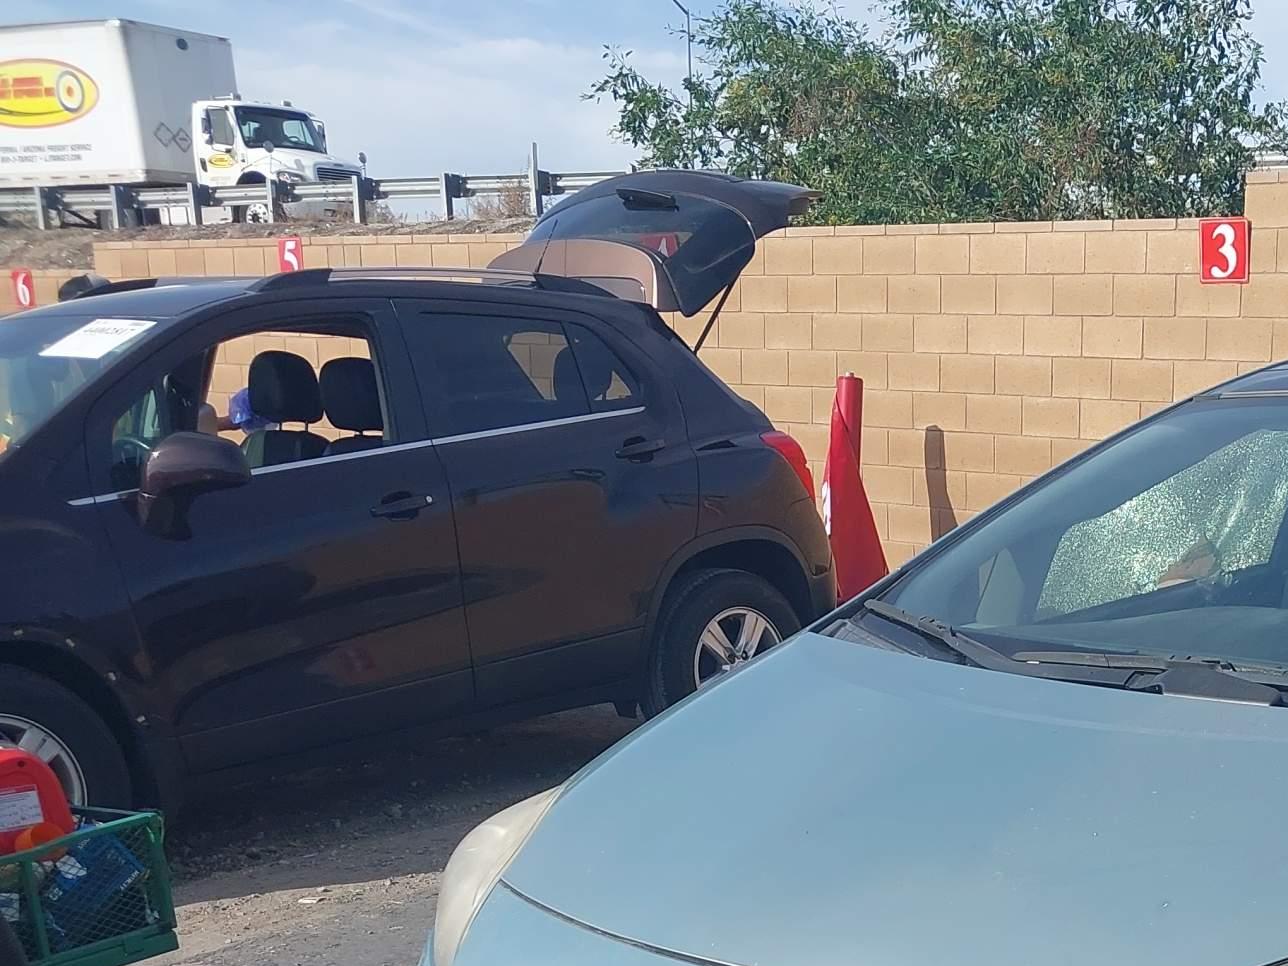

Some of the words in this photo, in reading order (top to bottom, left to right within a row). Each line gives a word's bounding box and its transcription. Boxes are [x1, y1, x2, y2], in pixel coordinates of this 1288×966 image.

[284, 240, 299, 272] 5
[1210, 223, 1238, 279] 3
[16, 271, 31, 306] 6
